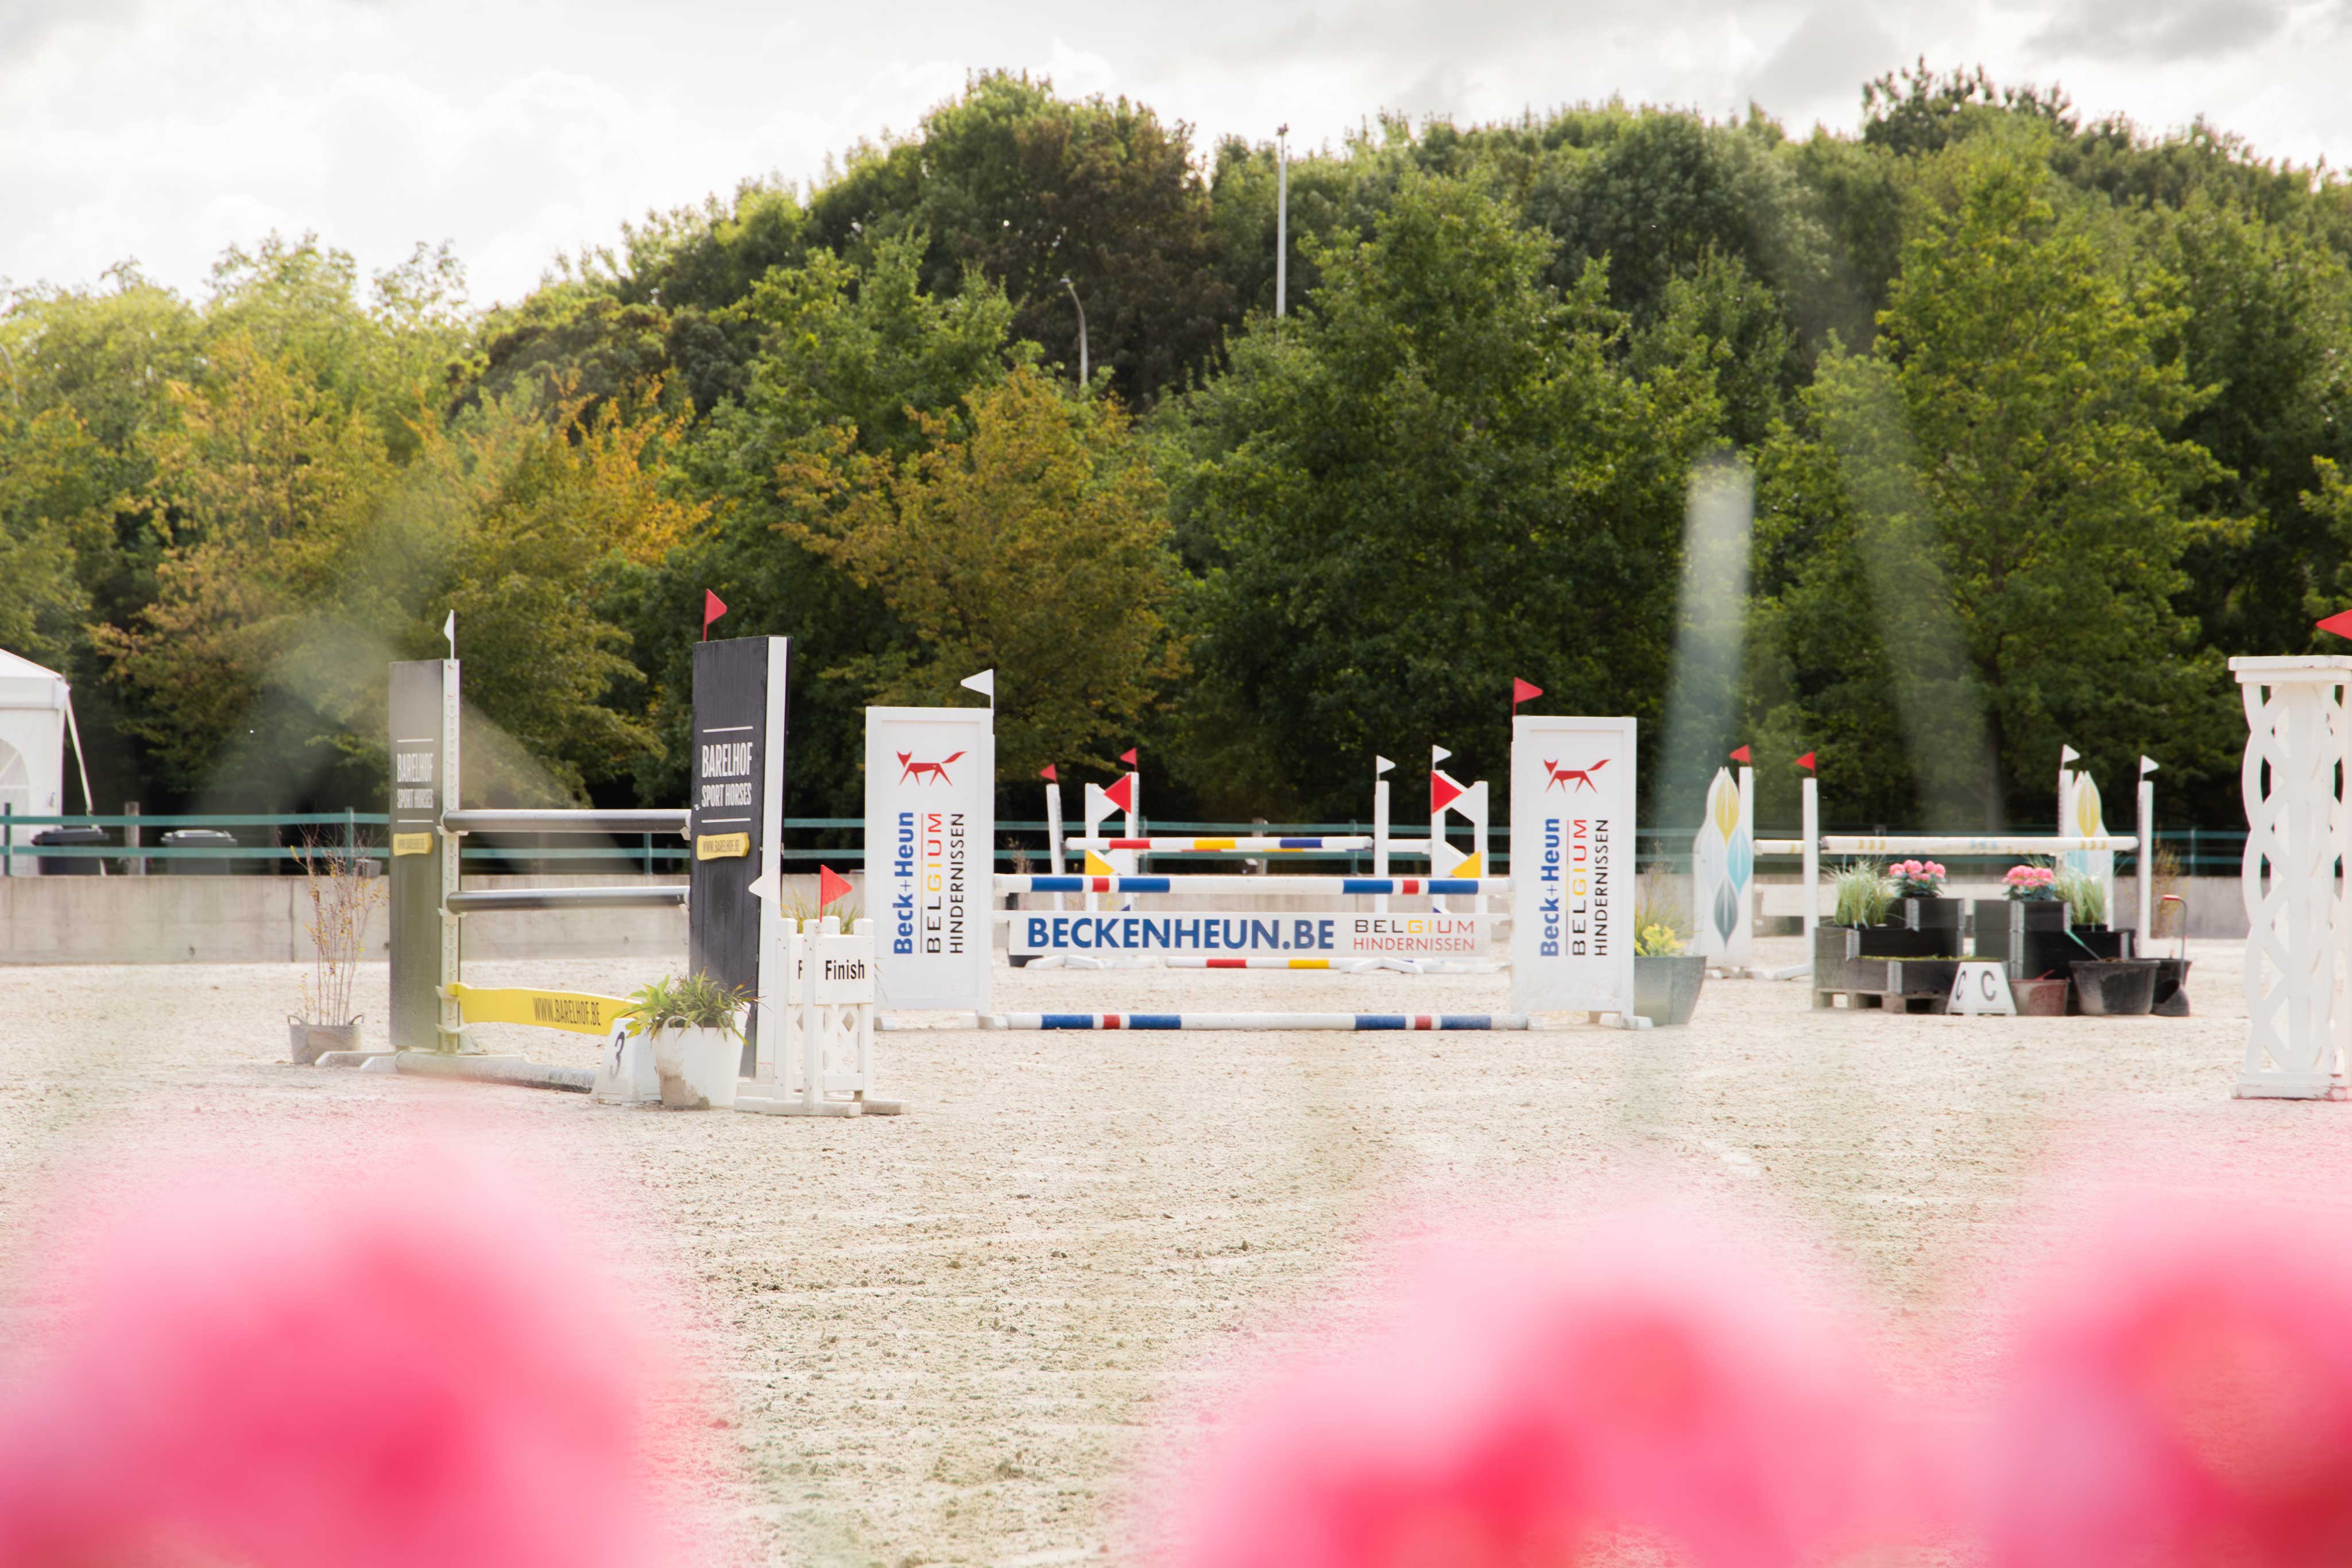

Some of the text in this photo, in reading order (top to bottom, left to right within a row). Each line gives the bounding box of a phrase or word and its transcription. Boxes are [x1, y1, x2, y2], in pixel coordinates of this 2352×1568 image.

[397, 753, 434, 783] BARELHOF
[702, 742, 753, 777] BARELHOF
[397, 788, 414, 808] SPORT
[702, 783, 752, 807] SPORT HORSES
[927, 814, 942, 953] BELGIUM
[950, 814, 965, 953] HINDERNISSEN
[1572, 820, 1587, 955] BELGIUM
[1595, 820, 1608, 955] HINDERNISSEN
[1027, 917, 1334, 950] BECKENHEUN.BE
[1355, 920, 1475, 934] BELGIUM
[1353, 938, 1475, 951] HINDERNISSEN
[825, 959, 865, 980] Finish
[1980, 970, 1997, 1001] C
[533, 997, 601, 1026] WWW.BARELHOF.BE
[610, 1031, 625, 1079] 3
